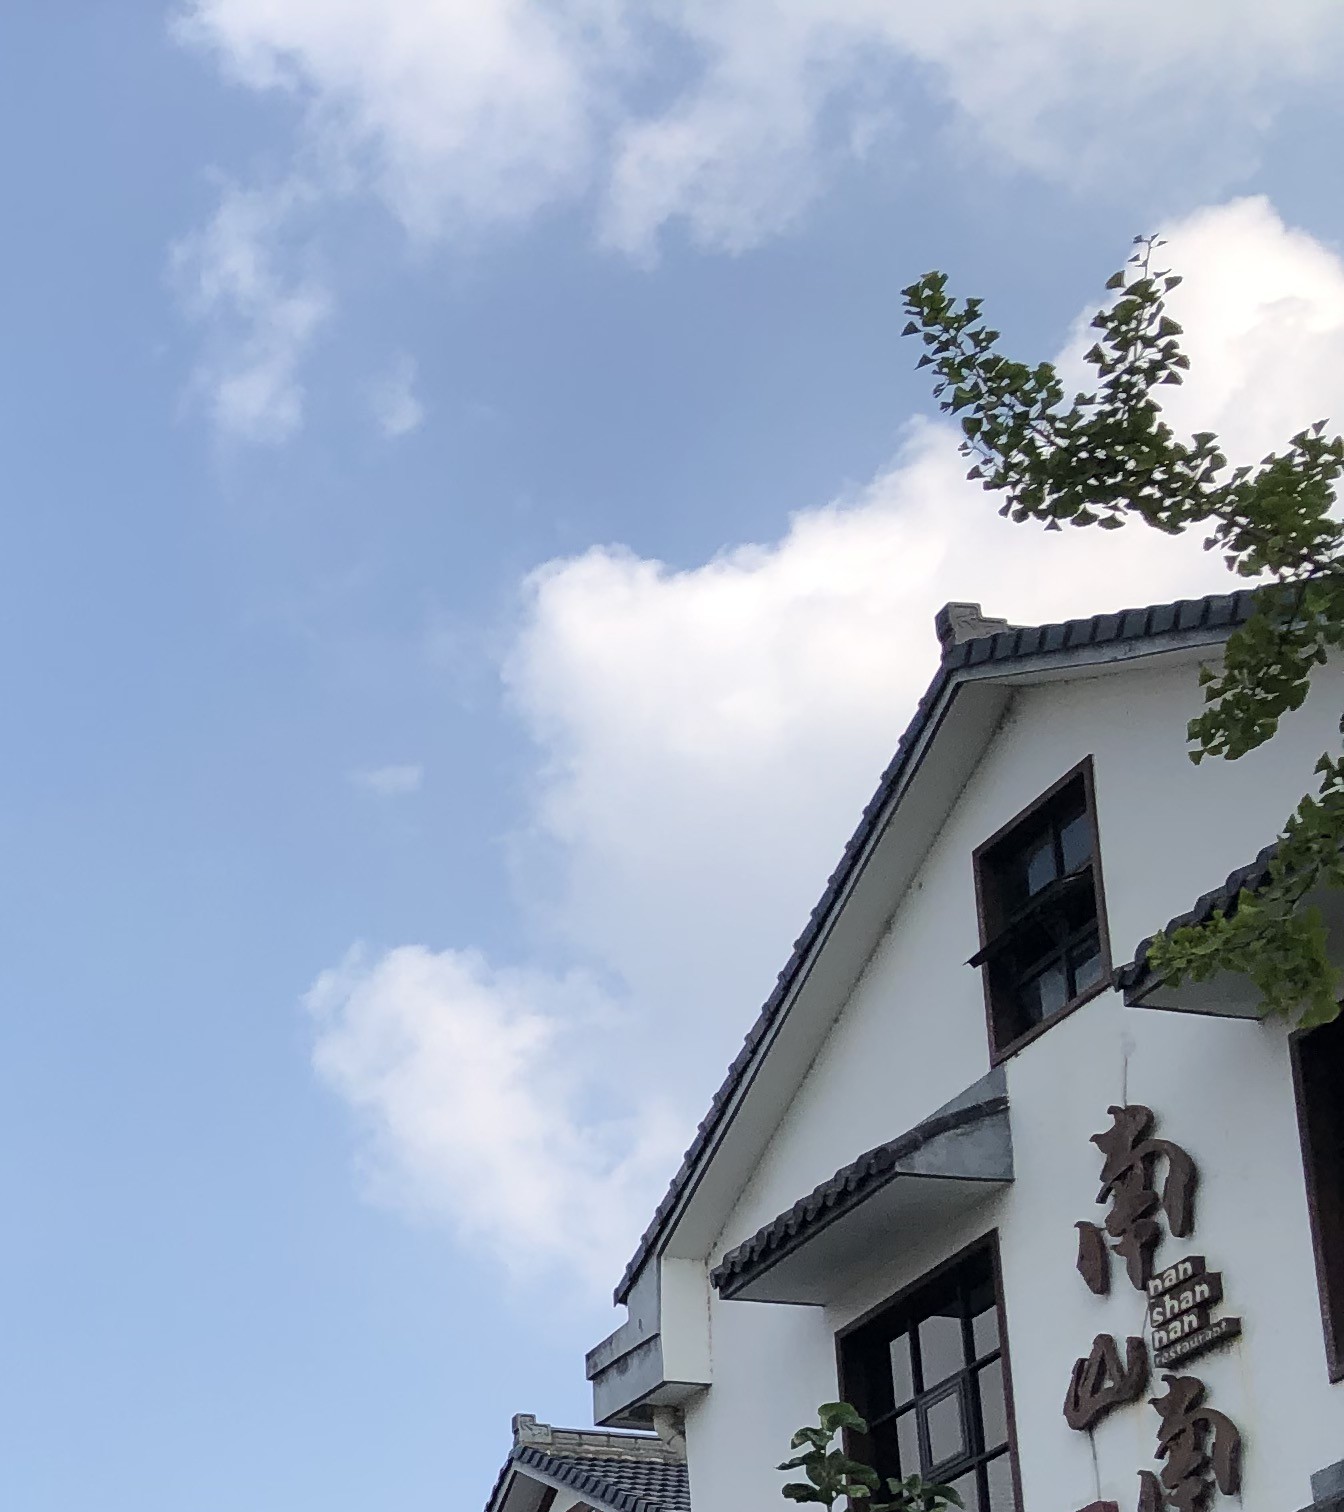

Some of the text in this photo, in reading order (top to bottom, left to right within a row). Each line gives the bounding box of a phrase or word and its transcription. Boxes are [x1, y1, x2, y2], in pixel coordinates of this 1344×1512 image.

[1149, 1261, 1192, 1297] nan
[1152, 1283, 1210, 1328] shan
[1153, 1313, 1198, 1349] nan
[1156, 1320, 1227, 1364] restaurant
